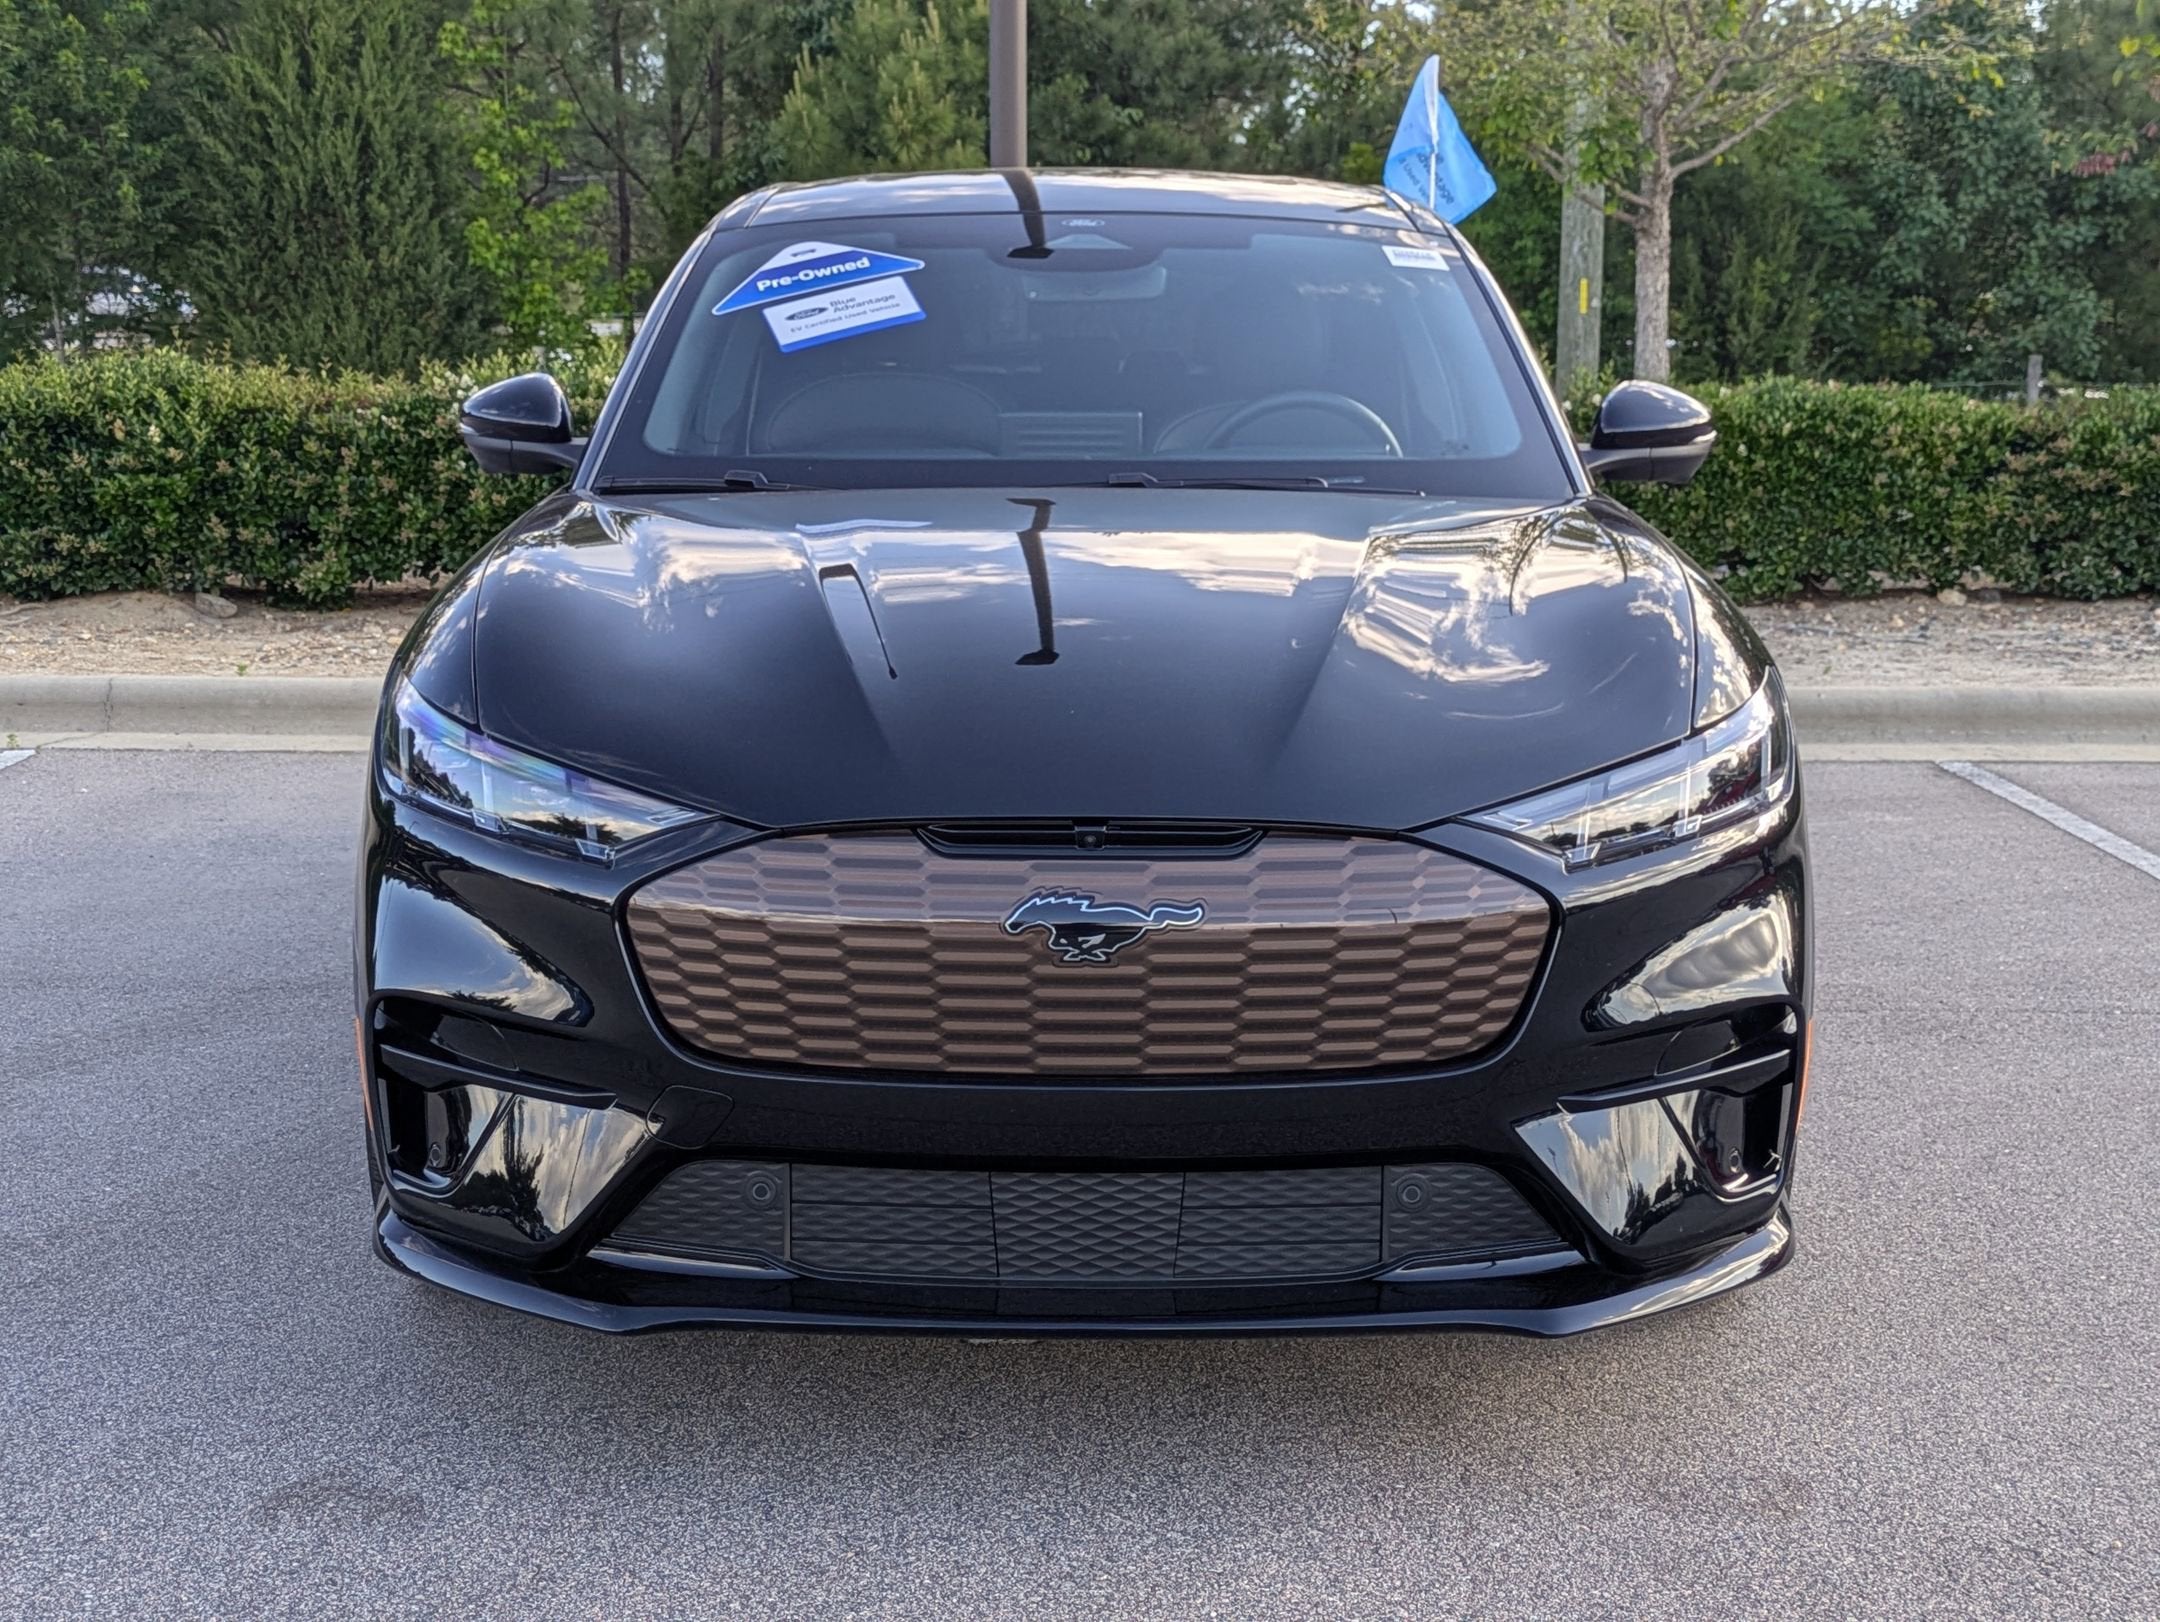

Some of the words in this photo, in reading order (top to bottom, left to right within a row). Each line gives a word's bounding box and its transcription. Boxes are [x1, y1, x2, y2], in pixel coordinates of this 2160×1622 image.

[756, 256, 871, 292] Pre-Owned
[829, 296, 857, 307] Blue
[833, 293, 896, 313] Advantage
[804, 316, 844, 329] Certified
[844, 309, 868, 320] Used
[870, 302, 901, 313] Vehicle
